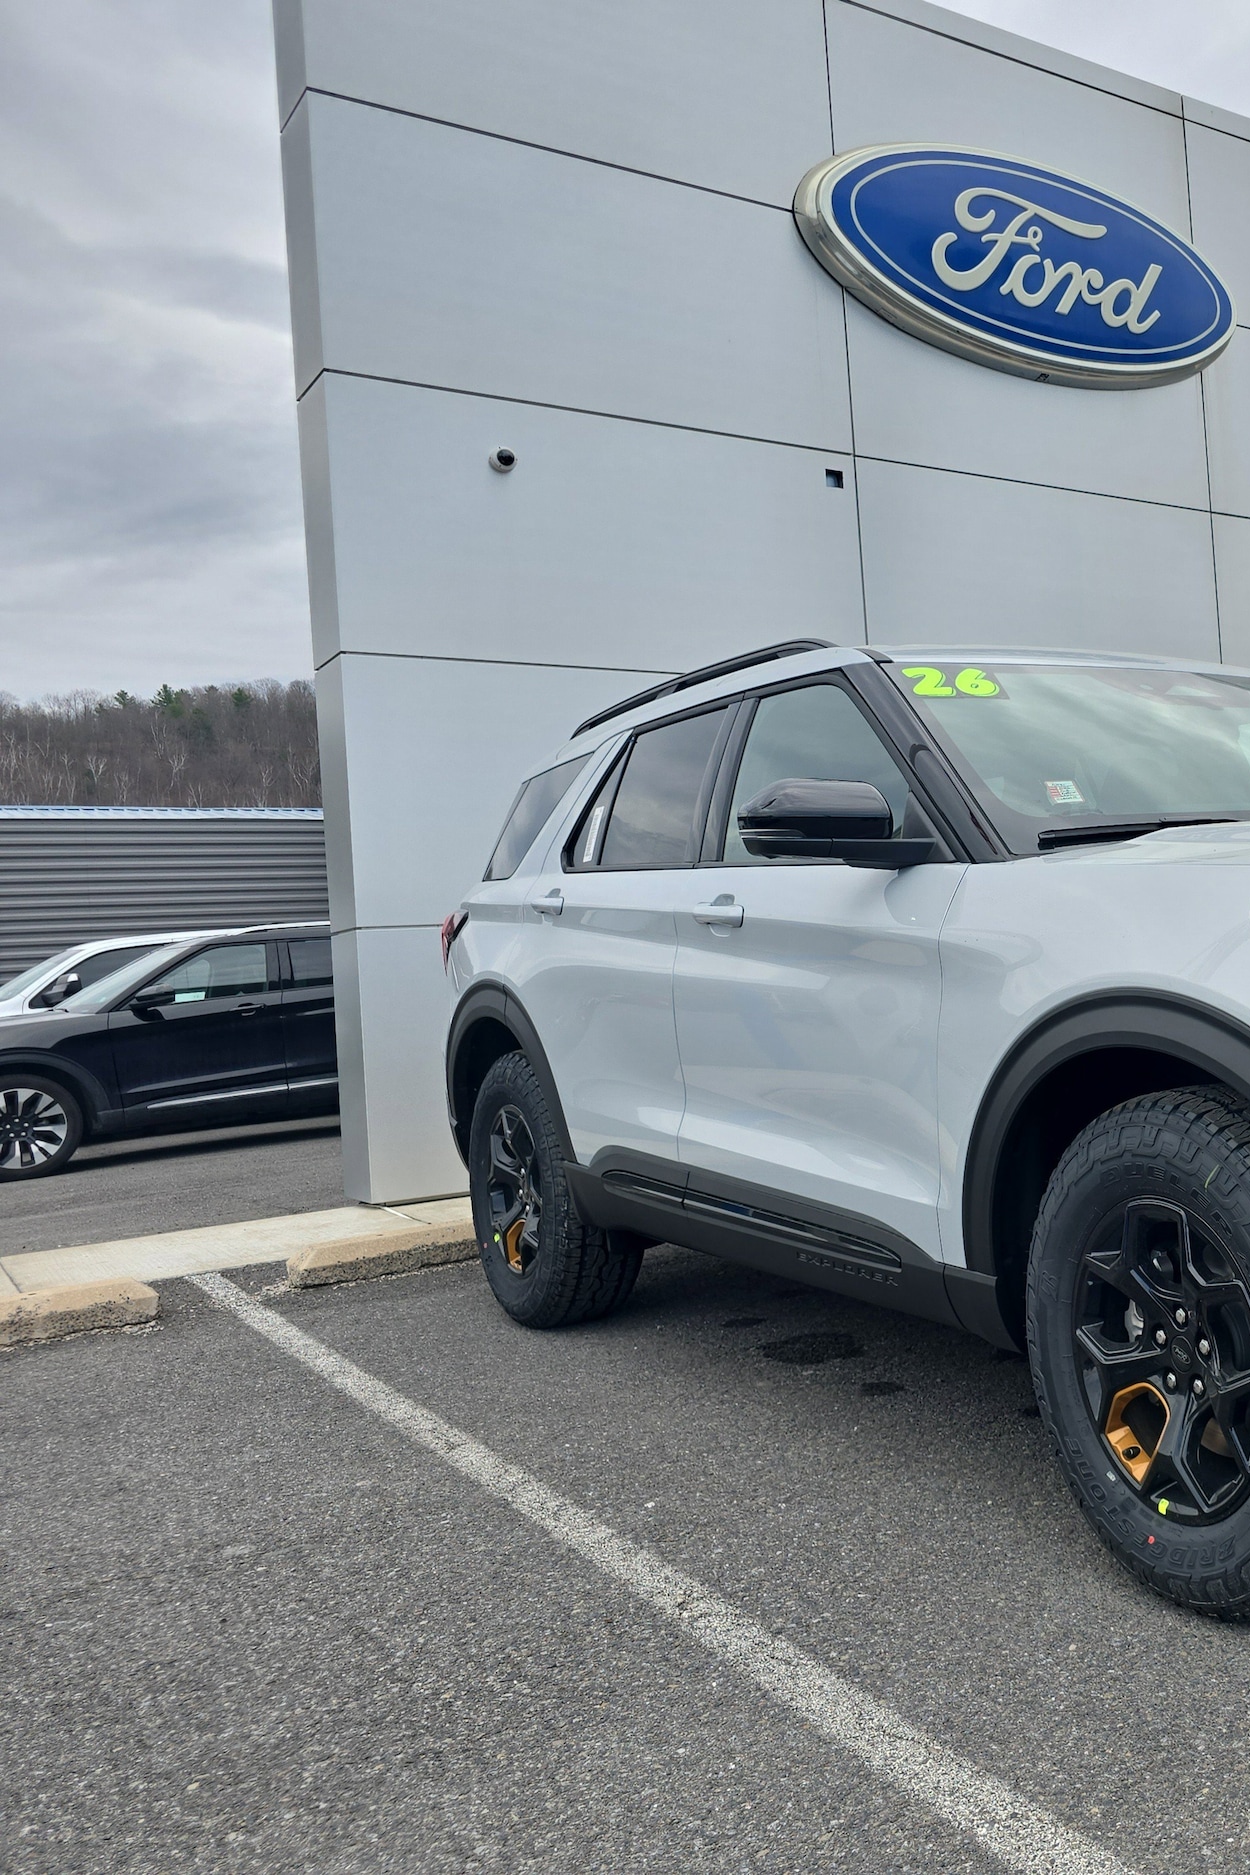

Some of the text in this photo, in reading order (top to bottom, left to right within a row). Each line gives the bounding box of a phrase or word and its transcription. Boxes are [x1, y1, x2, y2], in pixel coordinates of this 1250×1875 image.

[931, 187, 1163, 335] Ford
[902, 667, 1000, 697] 26
[1102, 1162, 1233, 1239] DUELER
[796, 1250, 899, 1287] EXPLORER
[1064, 1436, 1237, 1569] BRIDGESTONE
